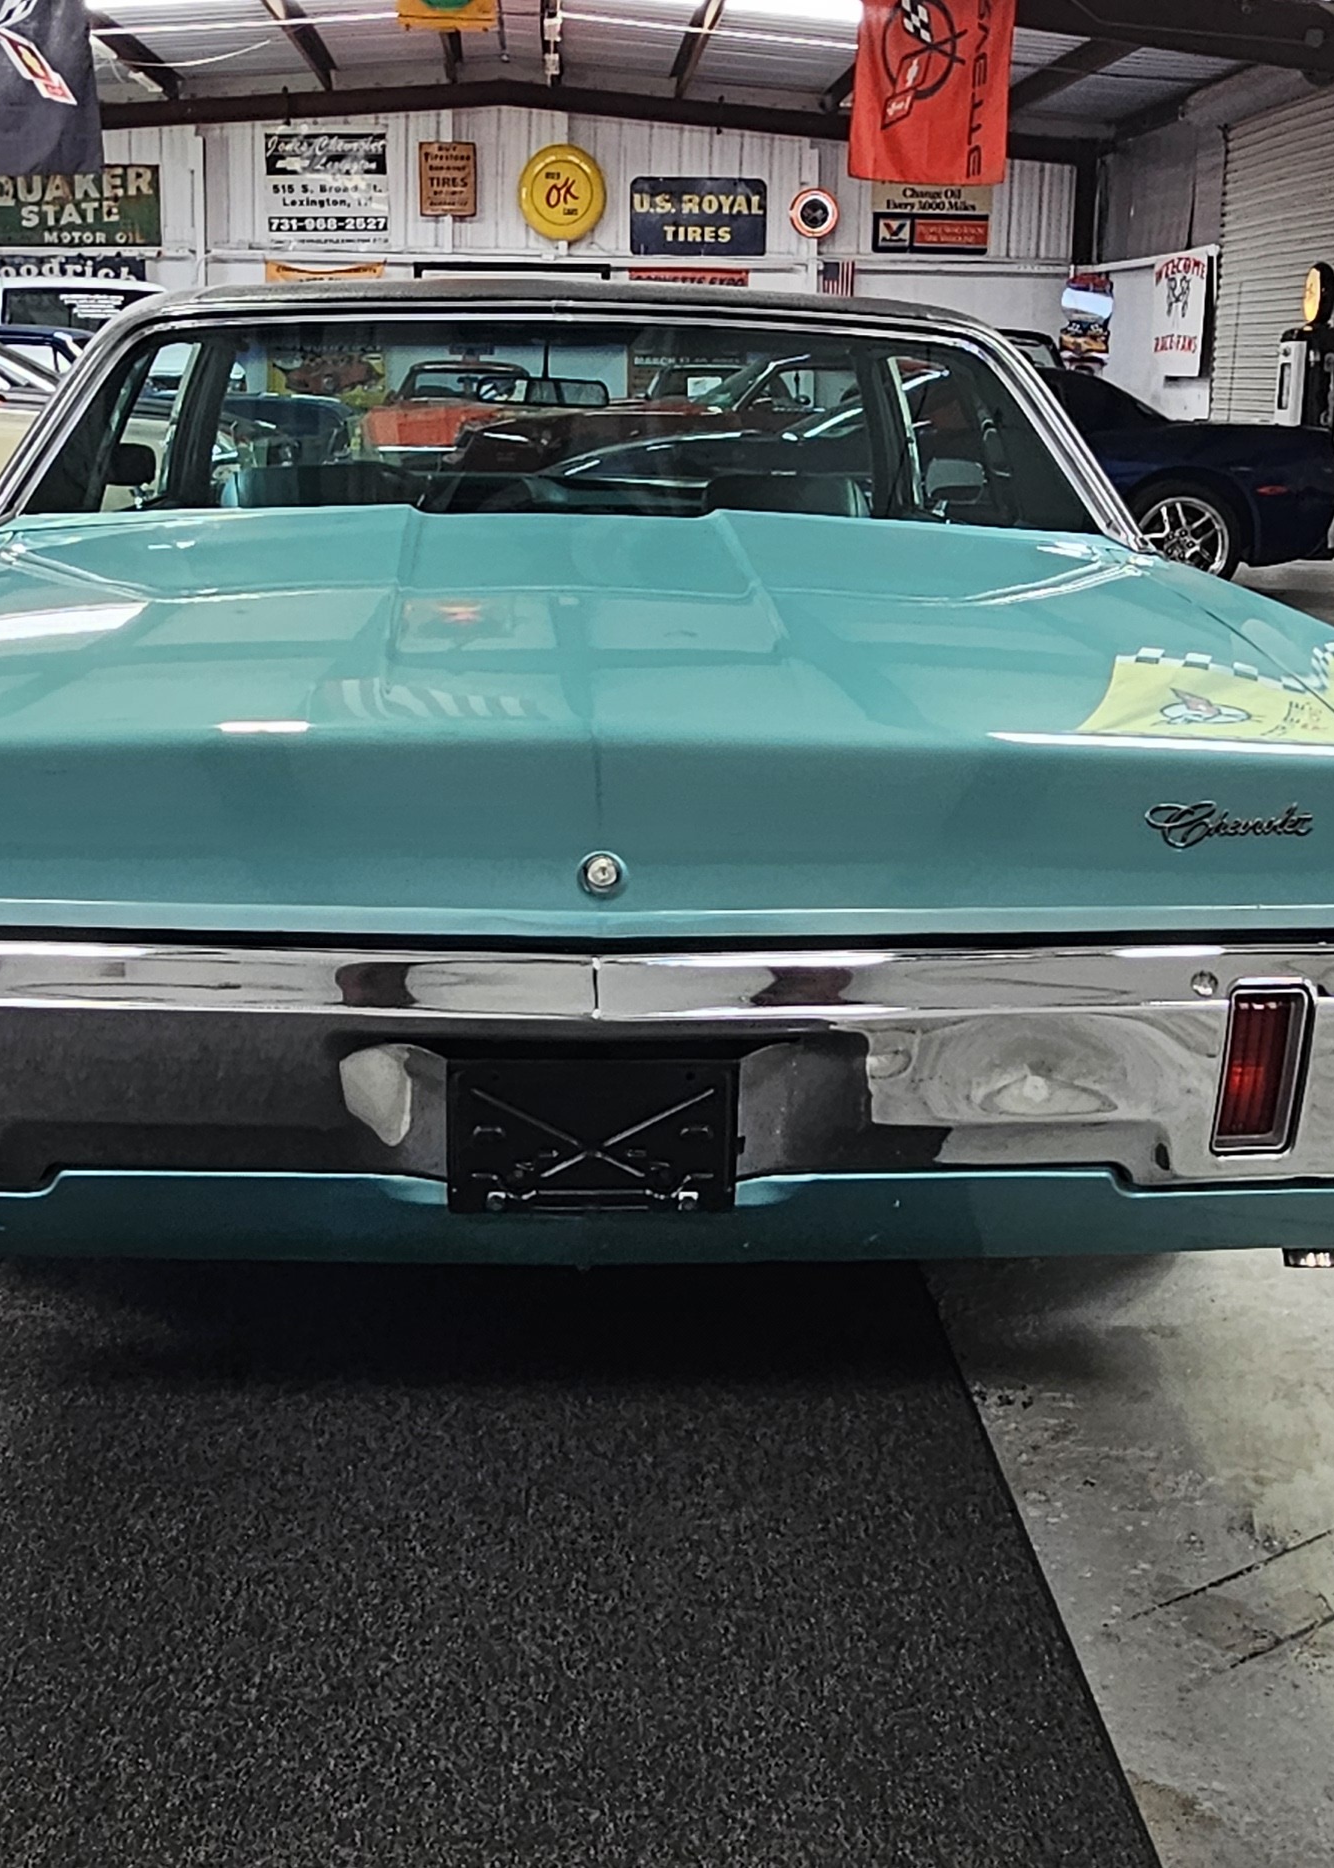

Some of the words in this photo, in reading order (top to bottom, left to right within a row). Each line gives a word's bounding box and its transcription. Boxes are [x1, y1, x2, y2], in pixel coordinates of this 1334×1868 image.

[272, 184, 295, 194] 515
[301, 184, 314, 194] S.
[429, 177, 468, 188] TIRES
[545, 176, 579, 209] OK
[633, 193, 676, 214] U.S.
[682, 194, 764, 214] ROYAL
[21, 201, 121, 228] STATE
[44, 231, 106, 244] MOTOR
[115, 231, 146, 244] OIL
[663, 225, 731, 242] TIRES
[1155, 256, 1206, 286] WELCOME
[1144, 799, 1314, 850] Chevrolet
